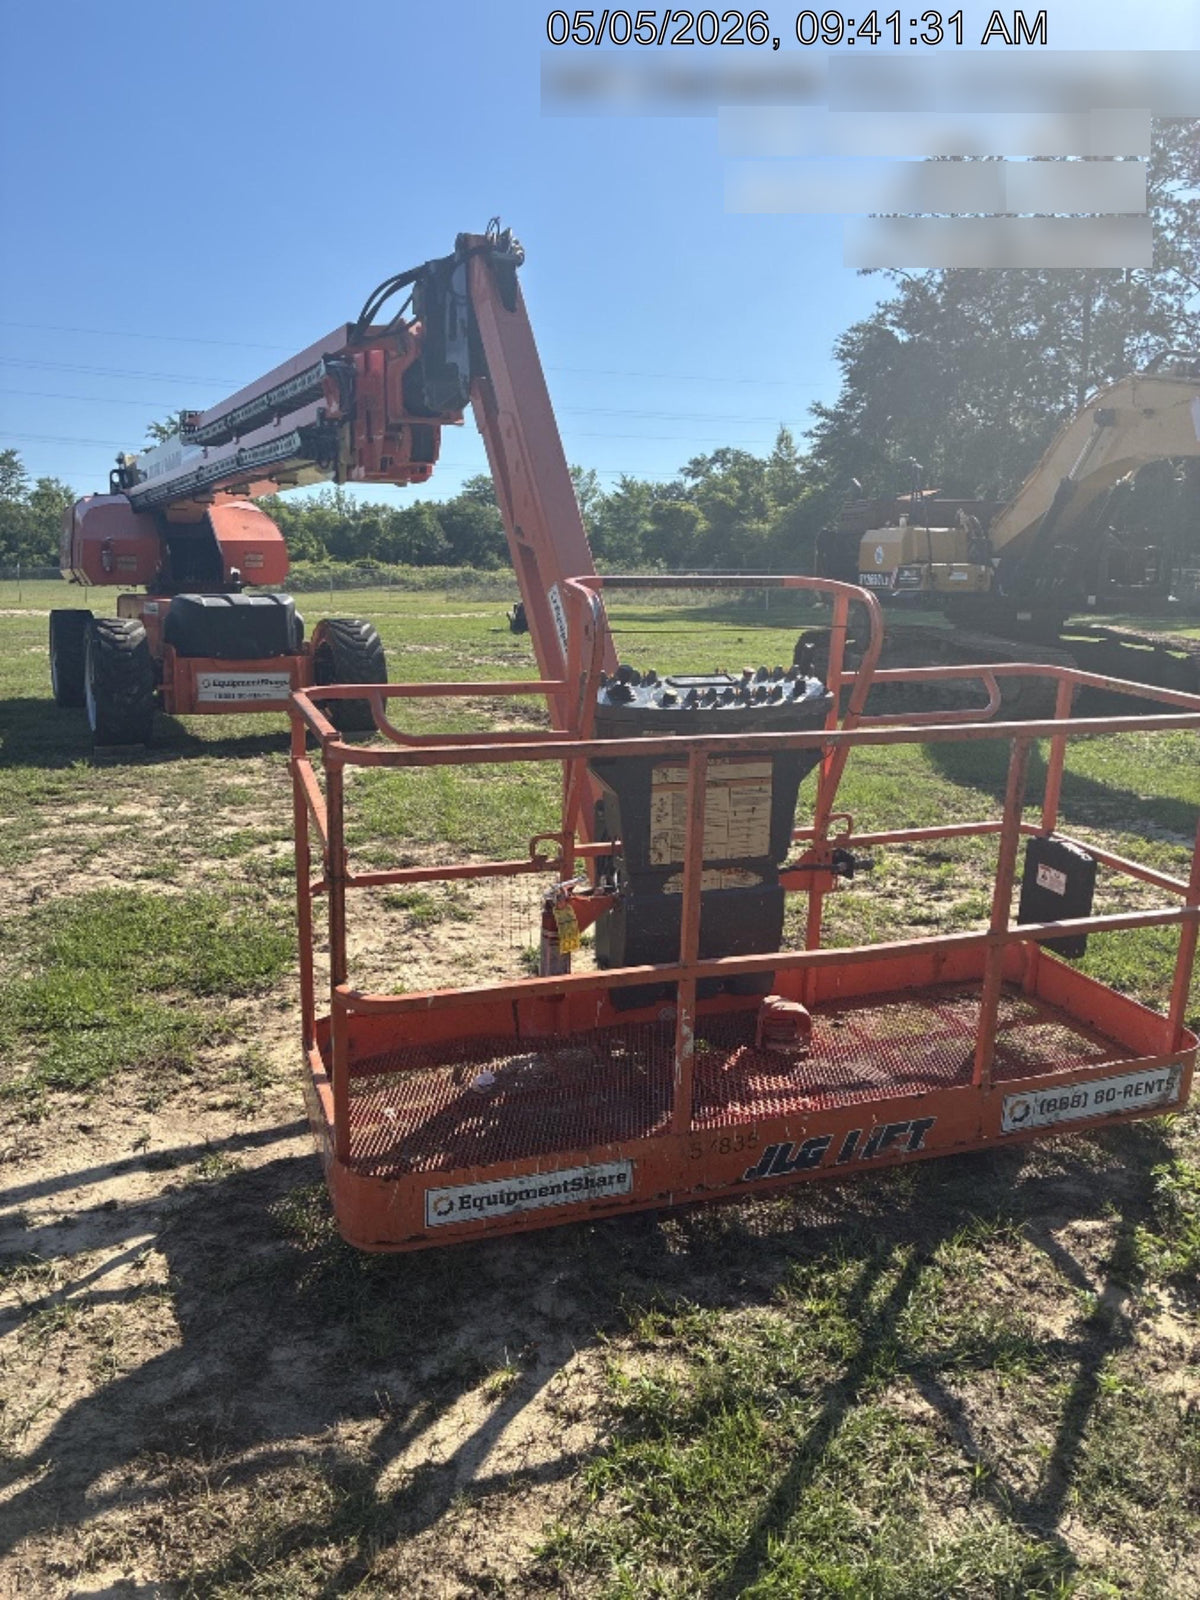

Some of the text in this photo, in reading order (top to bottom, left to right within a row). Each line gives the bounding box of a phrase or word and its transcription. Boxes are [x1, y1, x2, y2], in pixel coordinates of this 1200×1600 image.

[1039, 1091, 1089, 1115] (888)
[742, 1133, 835, 1181] JLG
[458, 1172, 627, 1211] EquipmentShare
